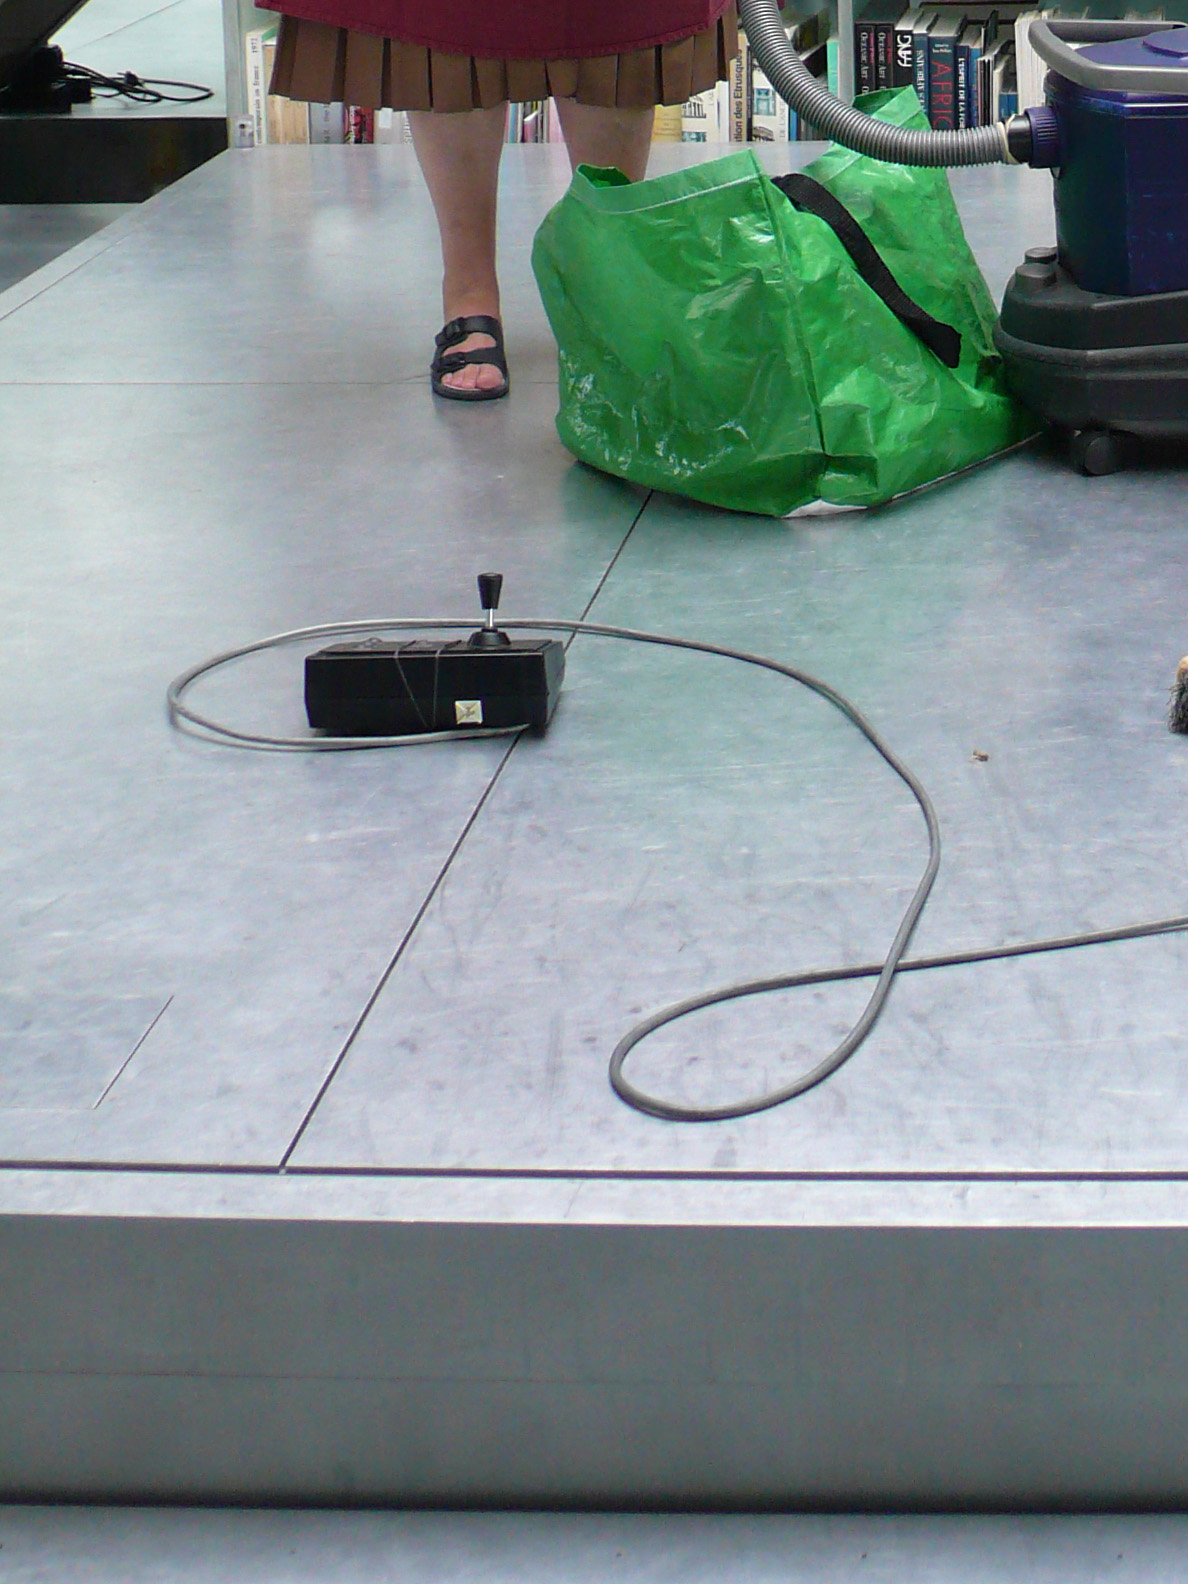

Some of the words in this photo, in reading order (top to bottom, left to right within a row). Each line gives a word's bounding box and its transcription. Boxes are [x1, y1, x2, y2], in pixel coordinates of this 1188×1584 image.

[897, 34, 912, 68] FANG
[915, 50, 926, 91] AFRICAINS
[958, 90, 965, 100] DE
[958, 102, 965, 112] LA
